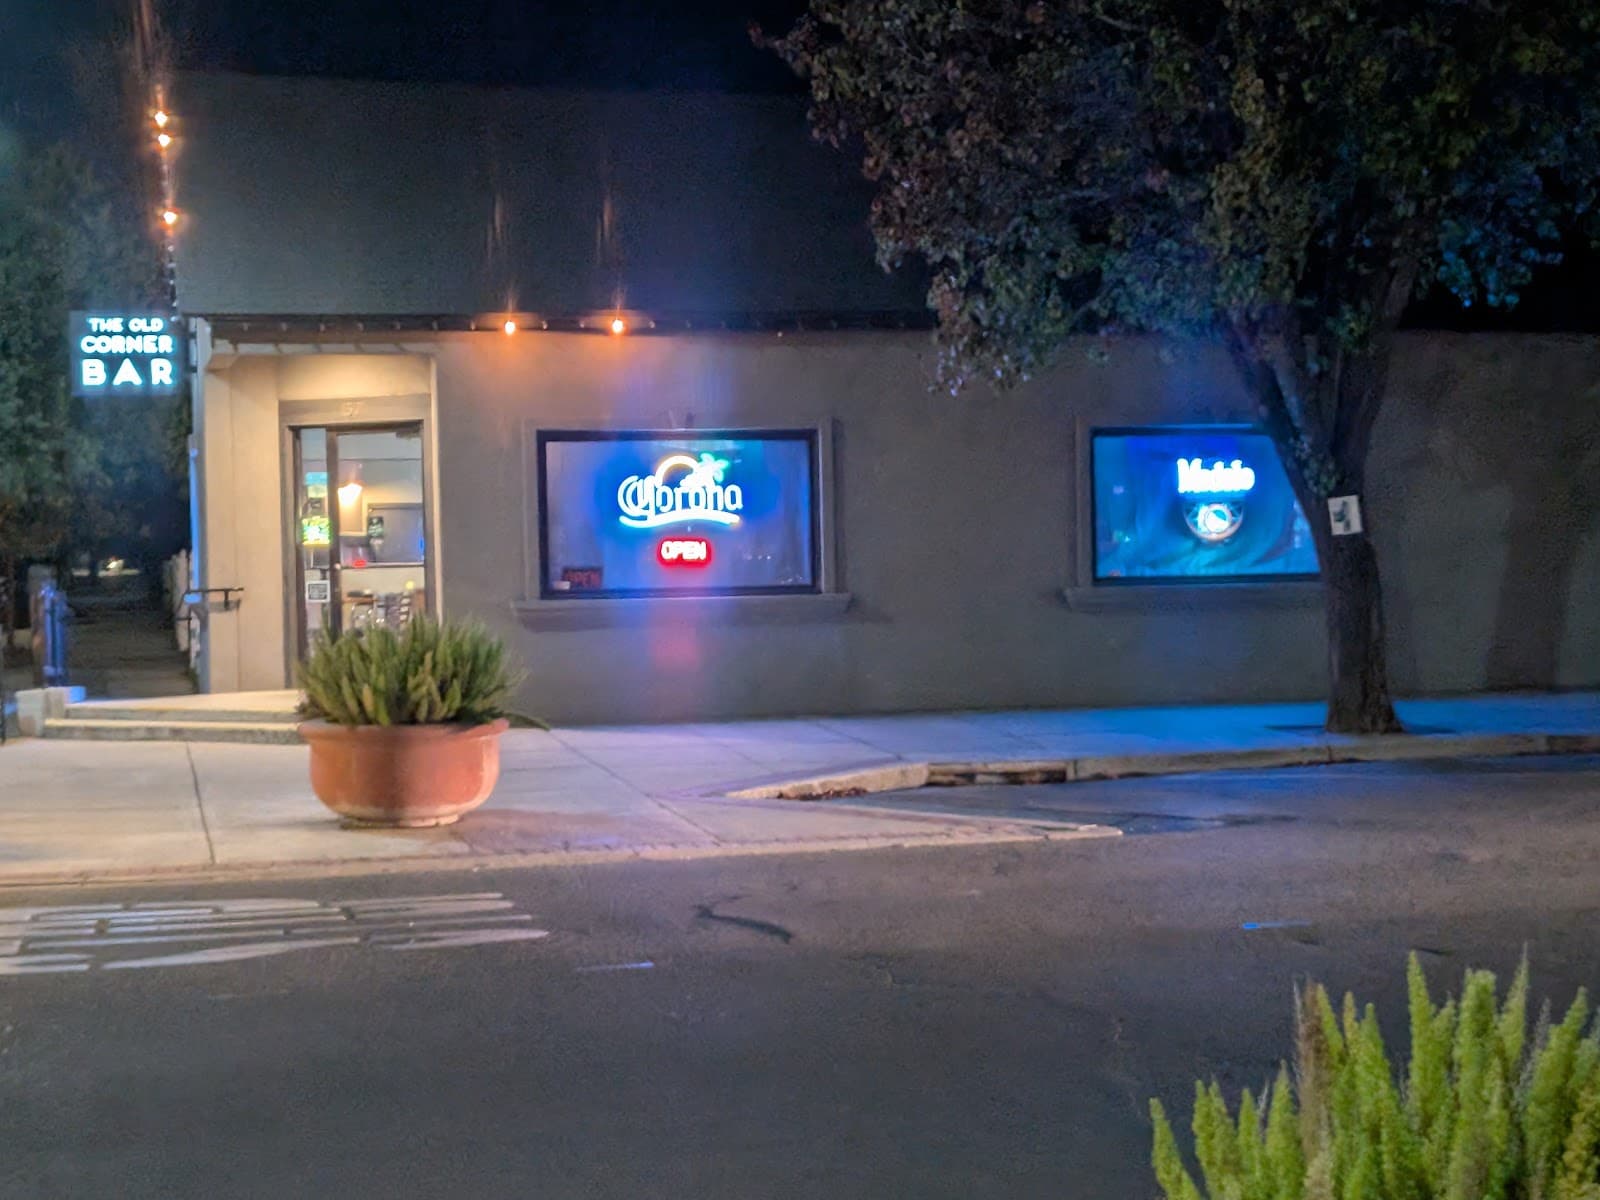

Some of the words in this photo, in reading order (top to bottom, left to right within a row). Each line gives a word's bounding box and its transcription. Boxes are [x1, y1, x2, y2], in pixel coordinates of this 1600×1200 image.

[88, 317, 124, 333] THE
[128, 317, 164, 333] OLD
[80, 335, 173, 354] CORNER
[81, 357, 173, 386] BAR
[616, 475, 744, 522] Corona
[660, 541, 707, 561] OPEN
